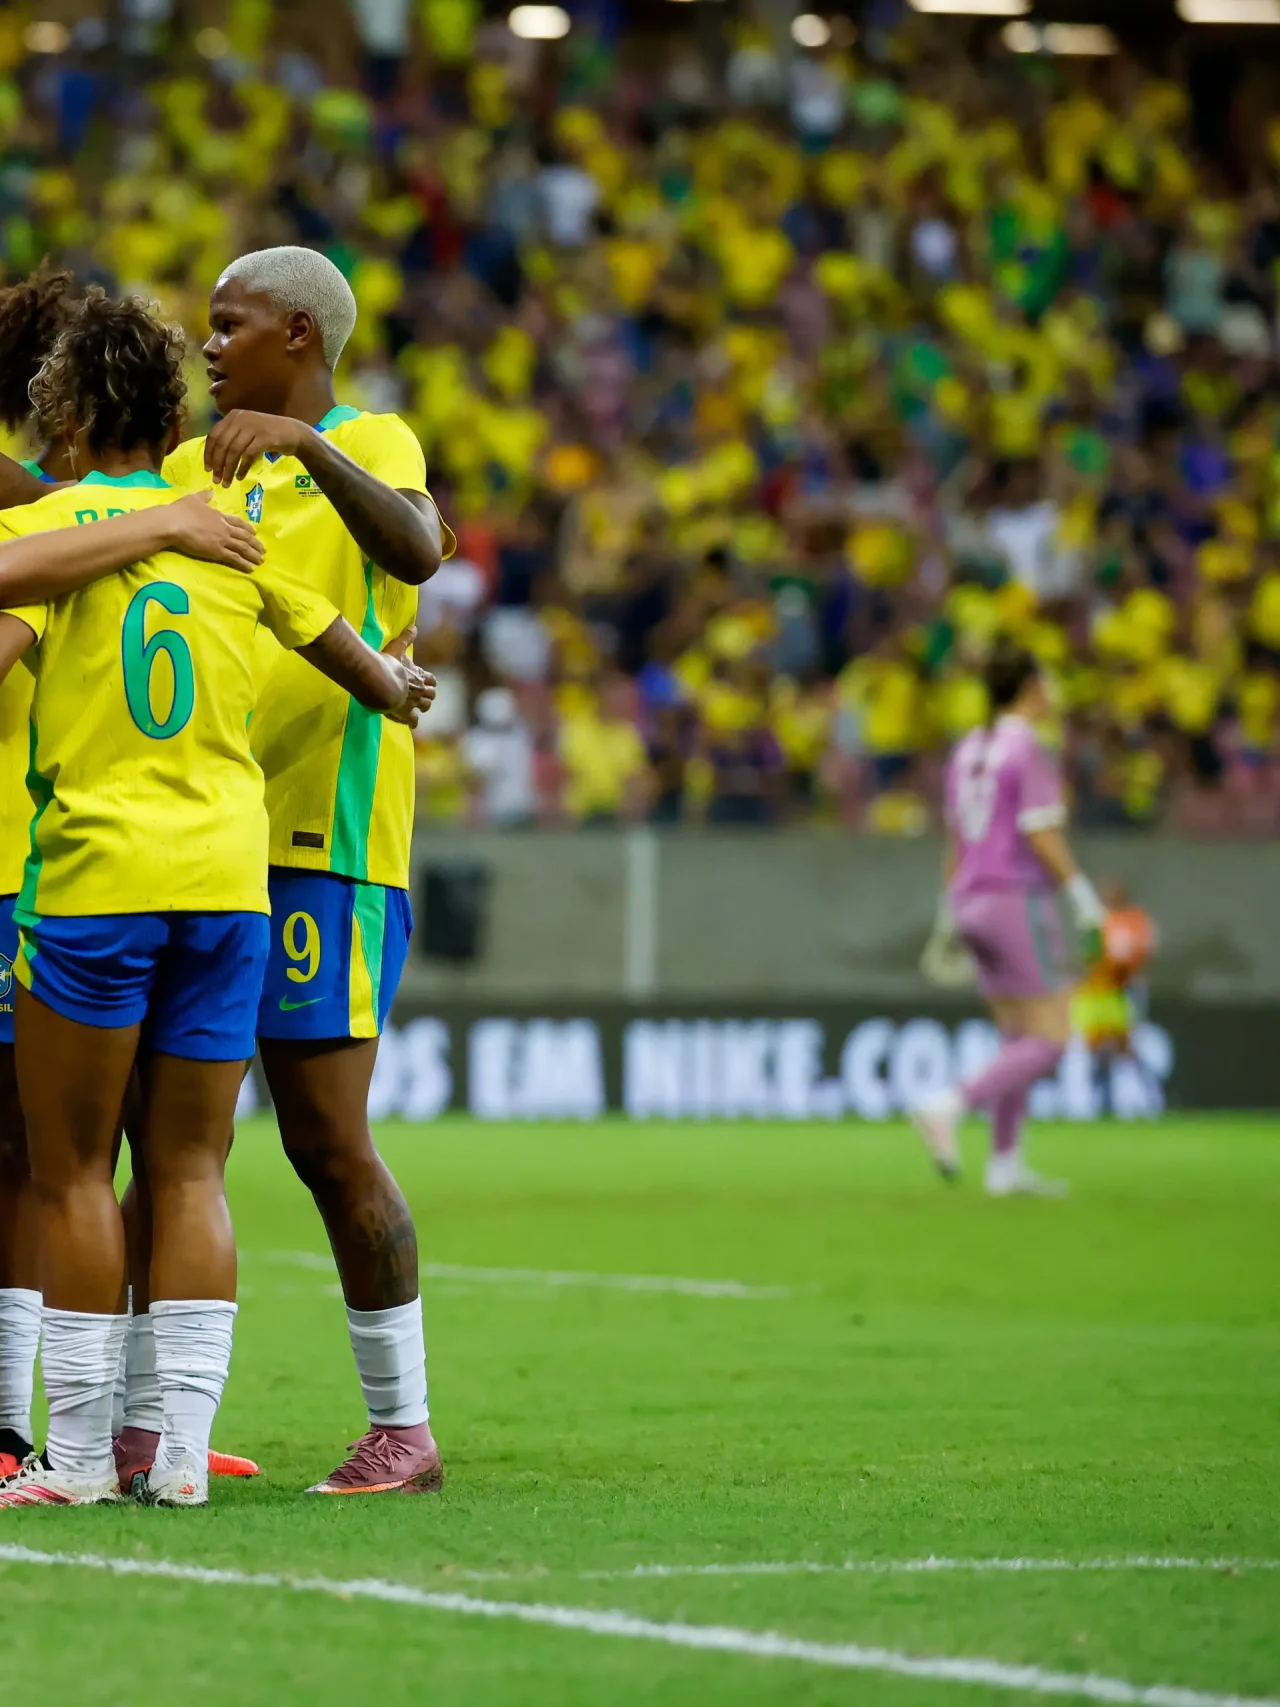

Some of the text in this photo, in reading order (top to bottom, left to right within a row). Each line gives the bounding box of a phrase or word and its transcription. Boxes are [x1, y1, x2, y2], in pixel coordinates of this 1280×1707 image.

[122, 581, 195, 739] 6
[283, 911, 321, 983] 9
[467, 1017, 605, 1121] EM
